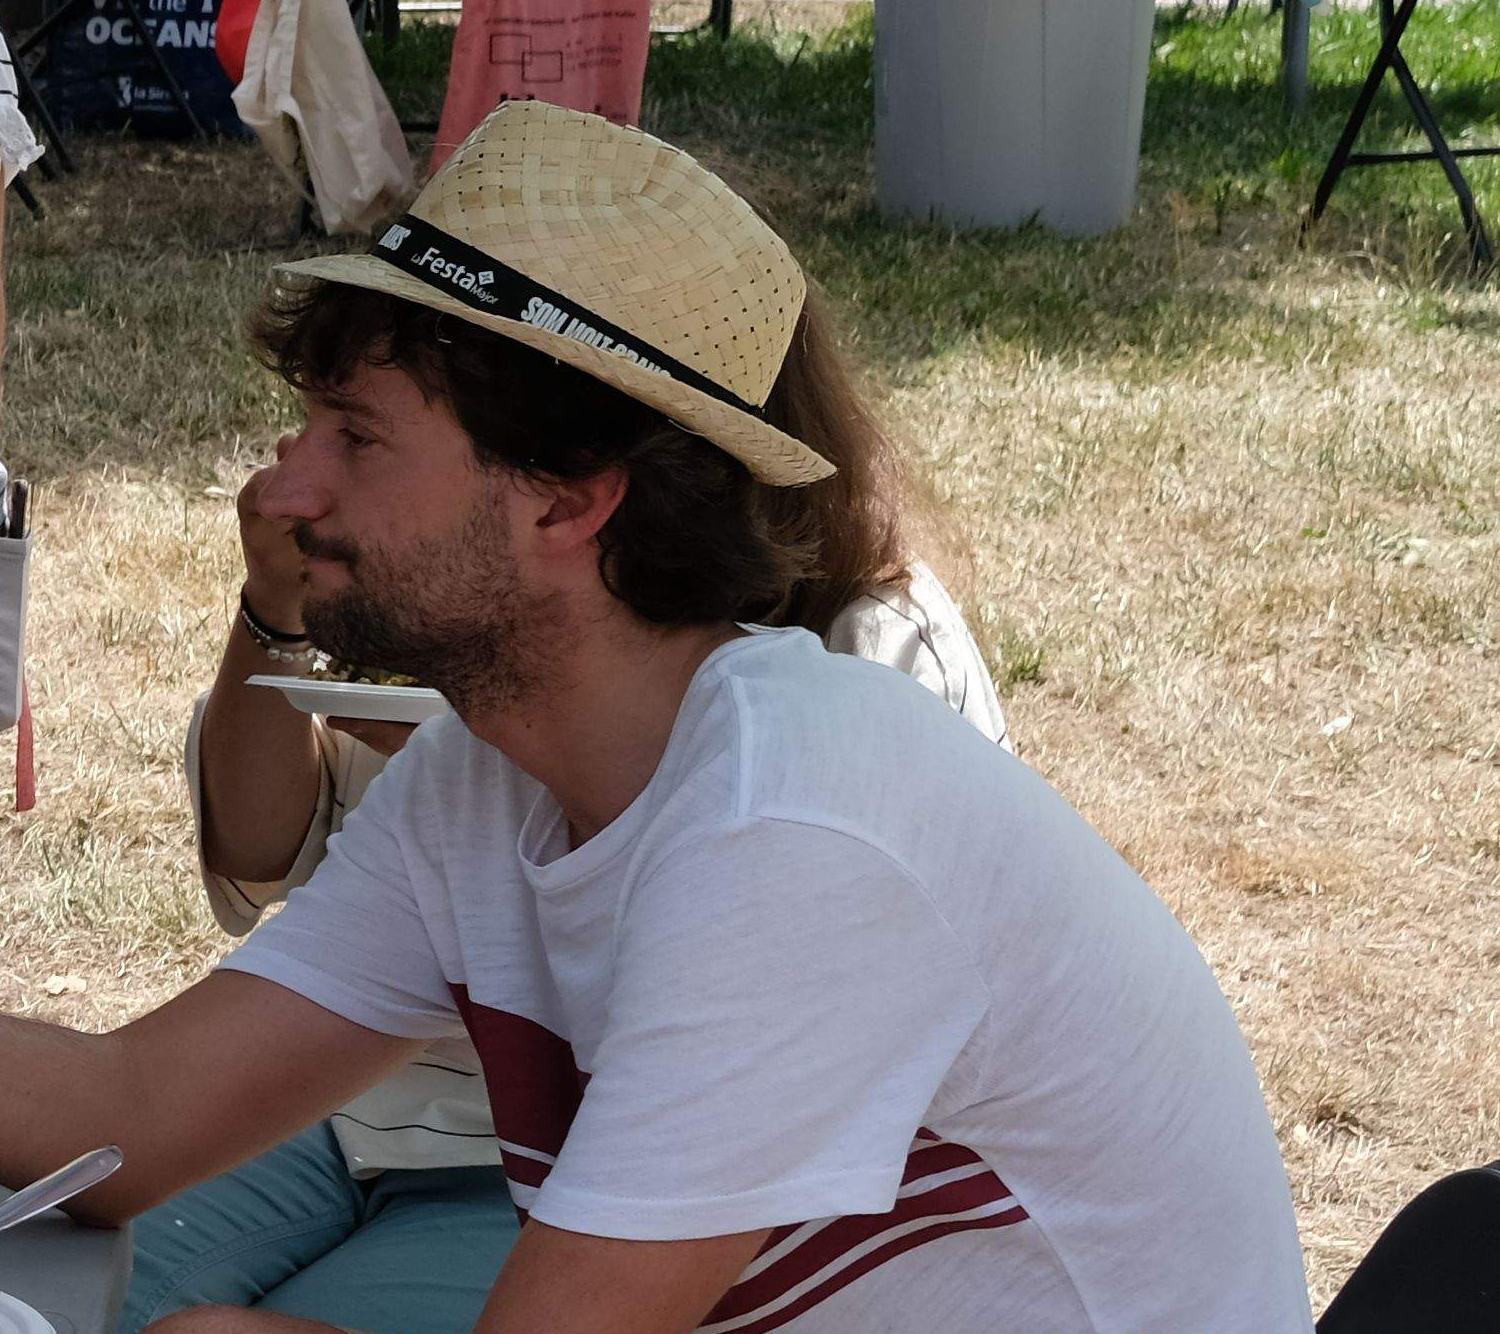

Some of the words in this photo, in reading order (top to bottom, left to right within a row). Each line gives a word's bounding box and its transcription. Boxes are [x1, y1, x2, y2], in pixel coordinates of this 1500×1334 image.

[417, 246, 478, 290] Festa
[468, 284, 499, 306] Major
[520, 296, 569, 335] SOM
